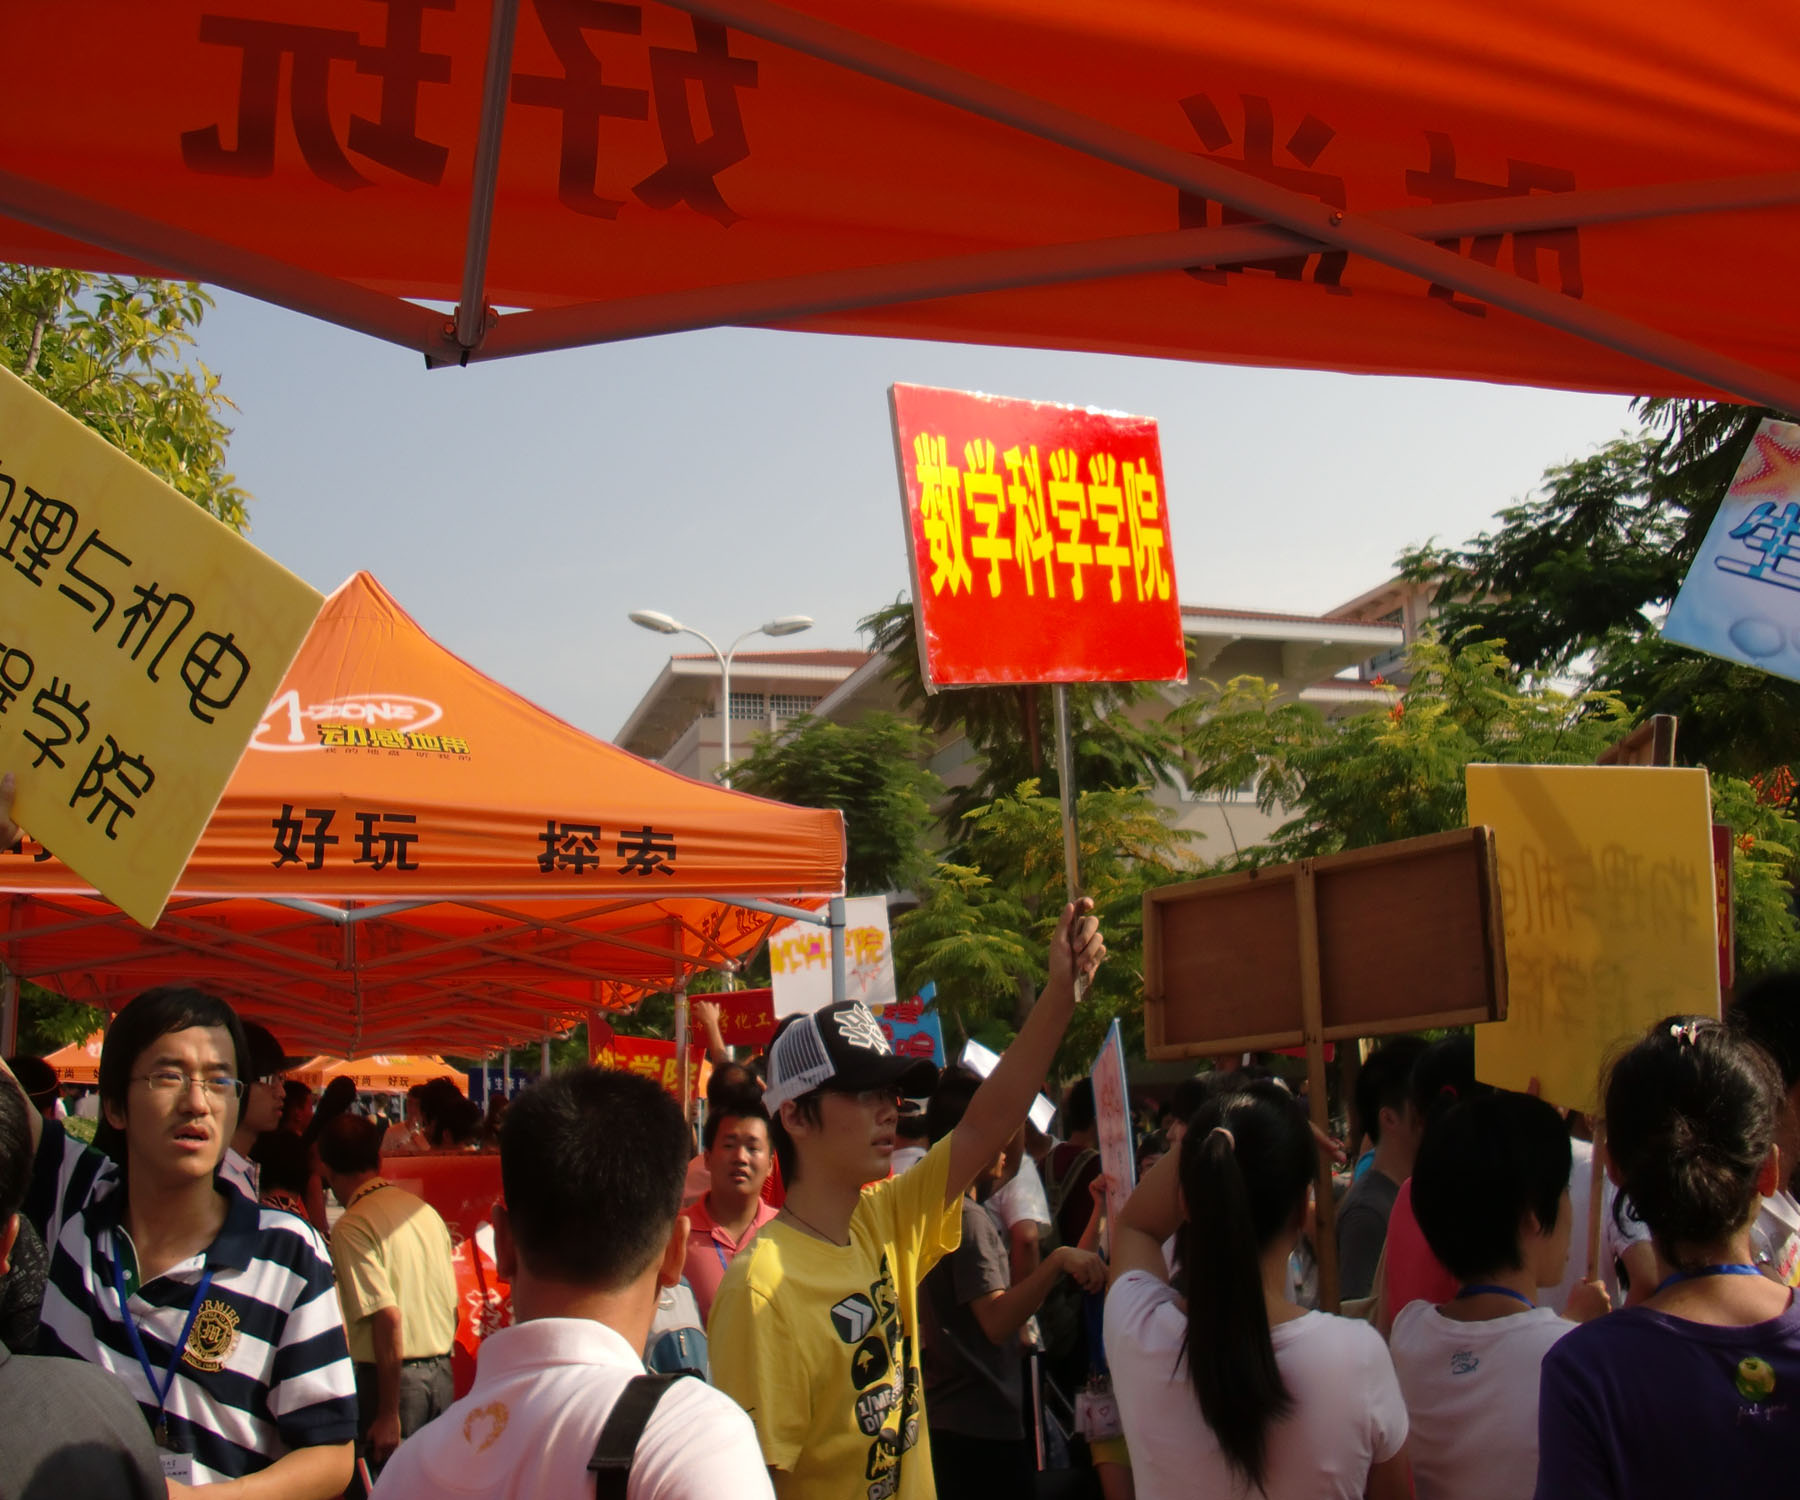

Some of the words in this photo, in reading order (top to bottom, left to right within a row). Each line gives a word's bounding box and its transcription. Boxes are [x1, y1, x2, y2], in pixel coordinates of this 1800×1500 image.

[913, 431, 1171, 603] 数学科学学院
[317, 723, 472, 755] 动感地带
[272, 804, 420, 872] 好玩
[537, 819, 677, 877] 探索
